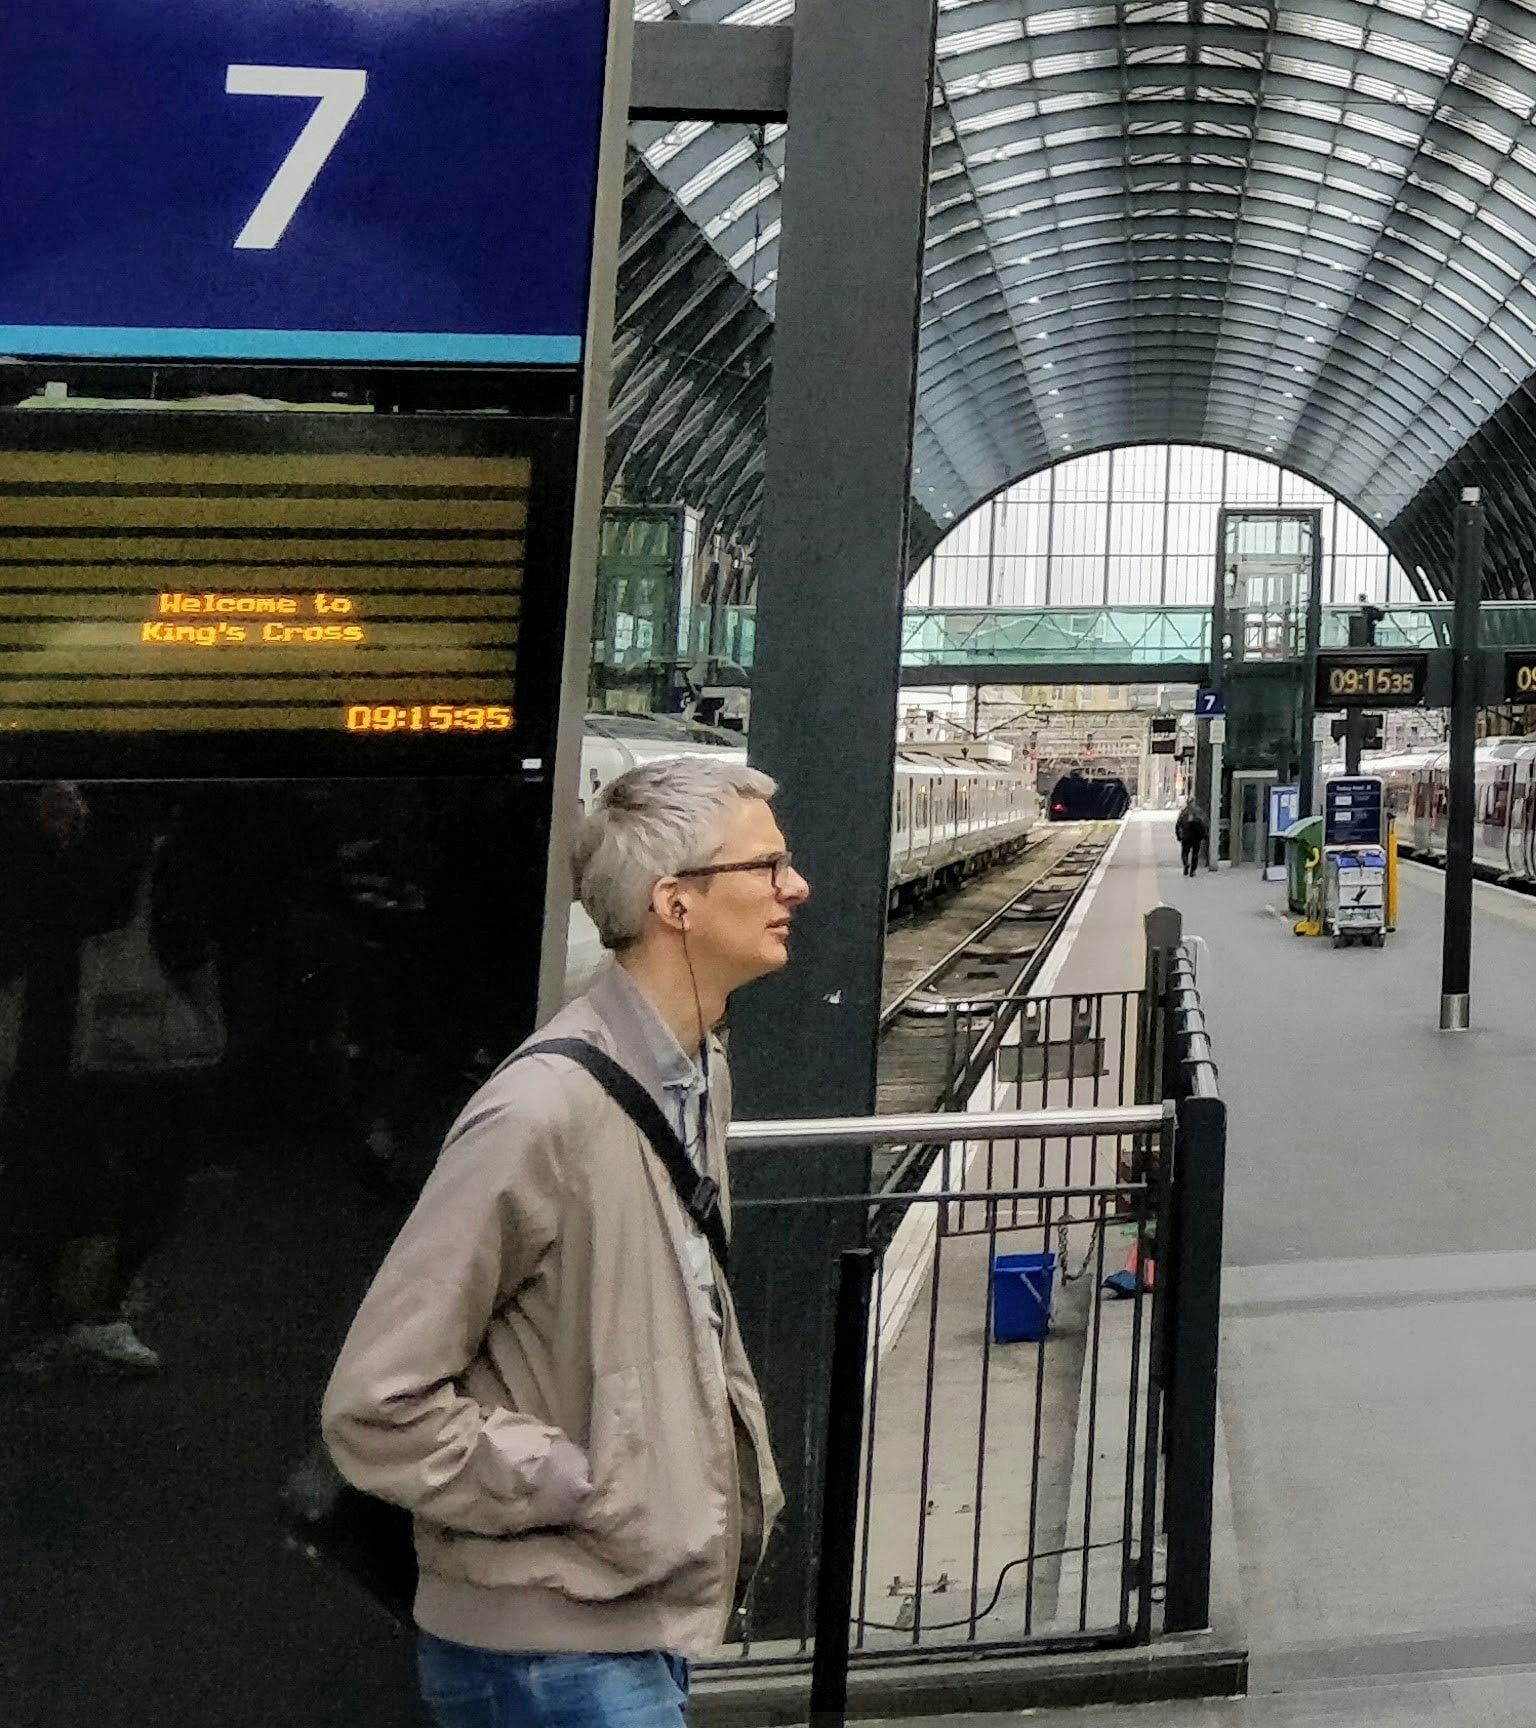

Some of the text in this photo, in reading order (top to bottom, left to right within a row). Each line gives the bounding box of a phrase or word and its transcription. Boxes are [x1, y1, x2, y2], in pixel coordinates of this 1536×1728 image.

[225, 64, 368, 250] 7
[159, 593, 352, 614] Welcome to
[142, 621, 365, 645] King's Cross
[1203, 694, 1217, 711] 7
[346, 705, 513, 731] 09:15:35
